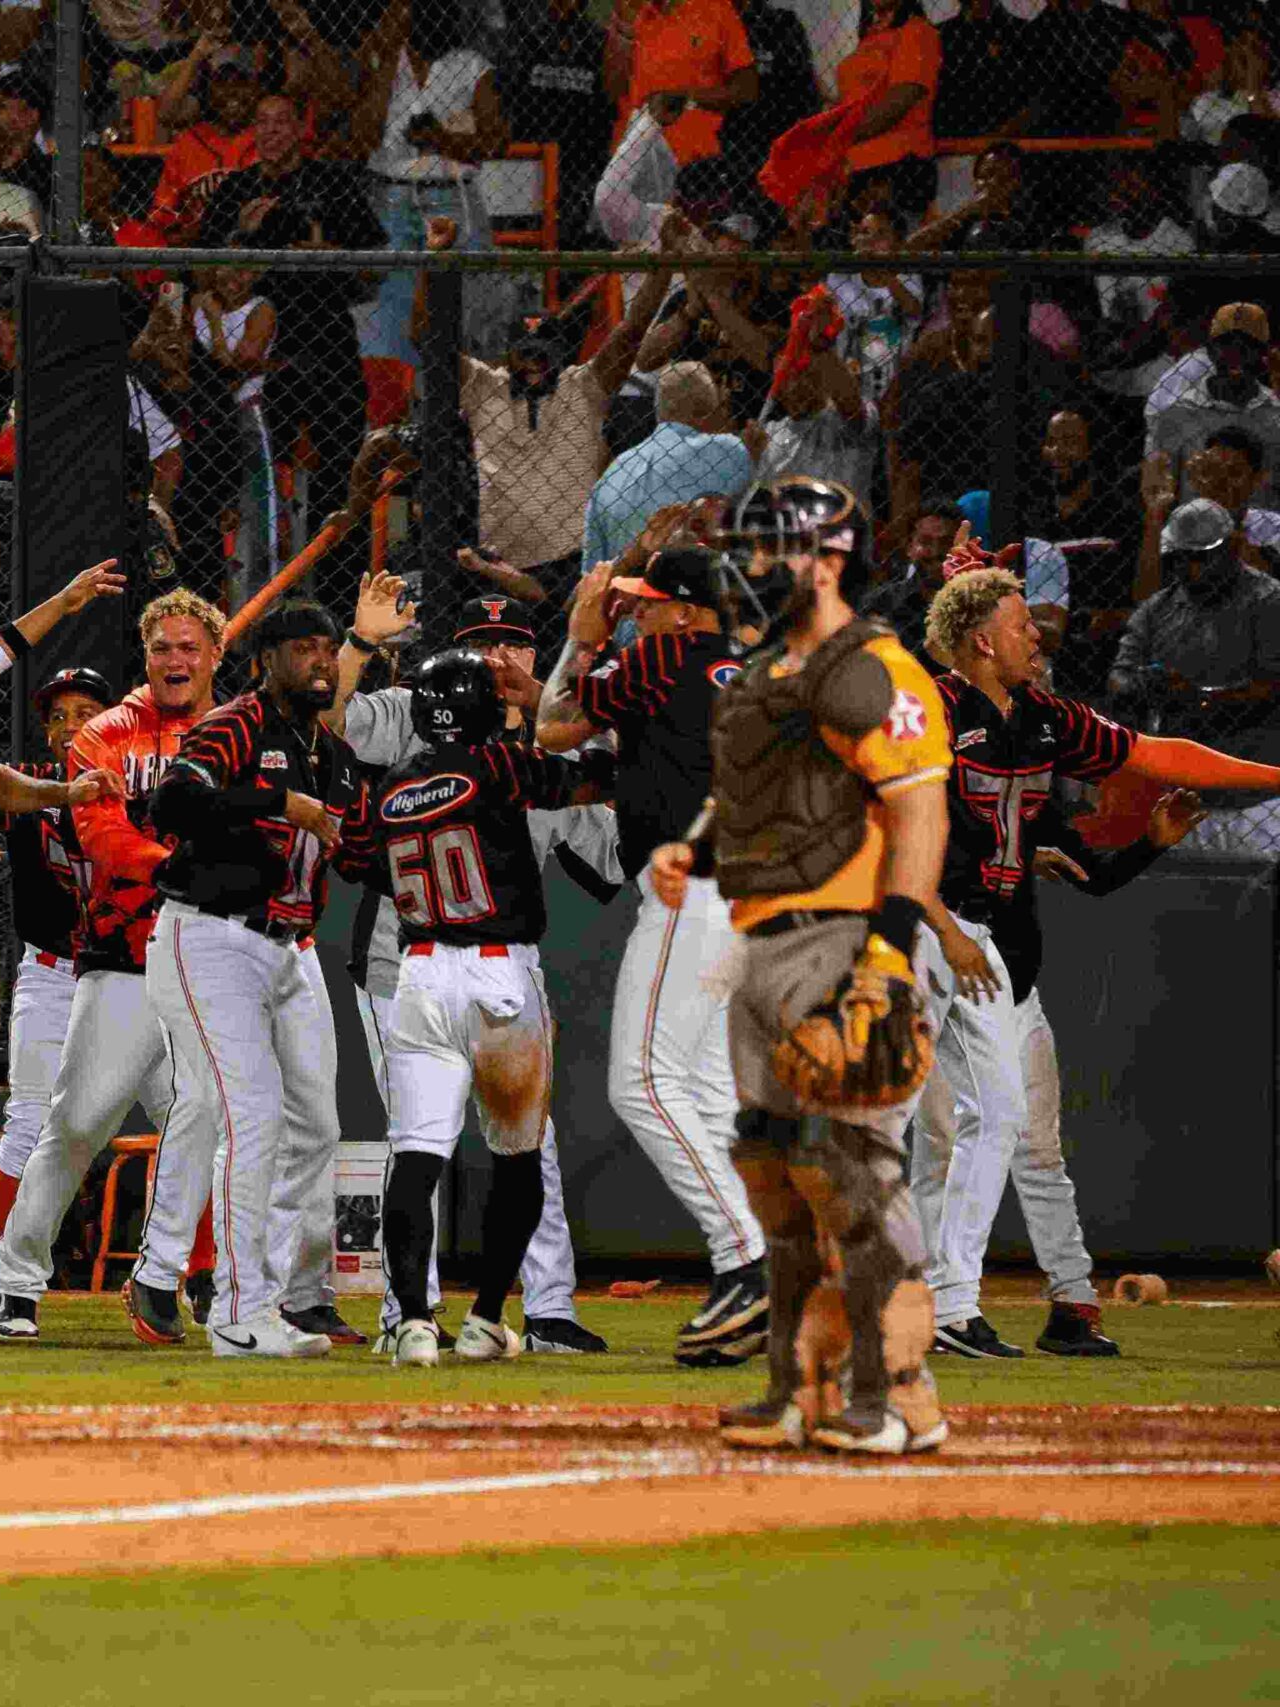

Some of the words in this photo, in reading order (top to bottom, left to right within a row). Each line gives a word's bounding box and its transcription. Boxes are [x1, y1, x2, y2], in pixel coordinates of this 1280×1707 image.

[481, 600, 507, 621] T
[433, 709, 454, 725] 50
[957, 754, 1054, 897] T
[386, 824, 498, 928] 50
